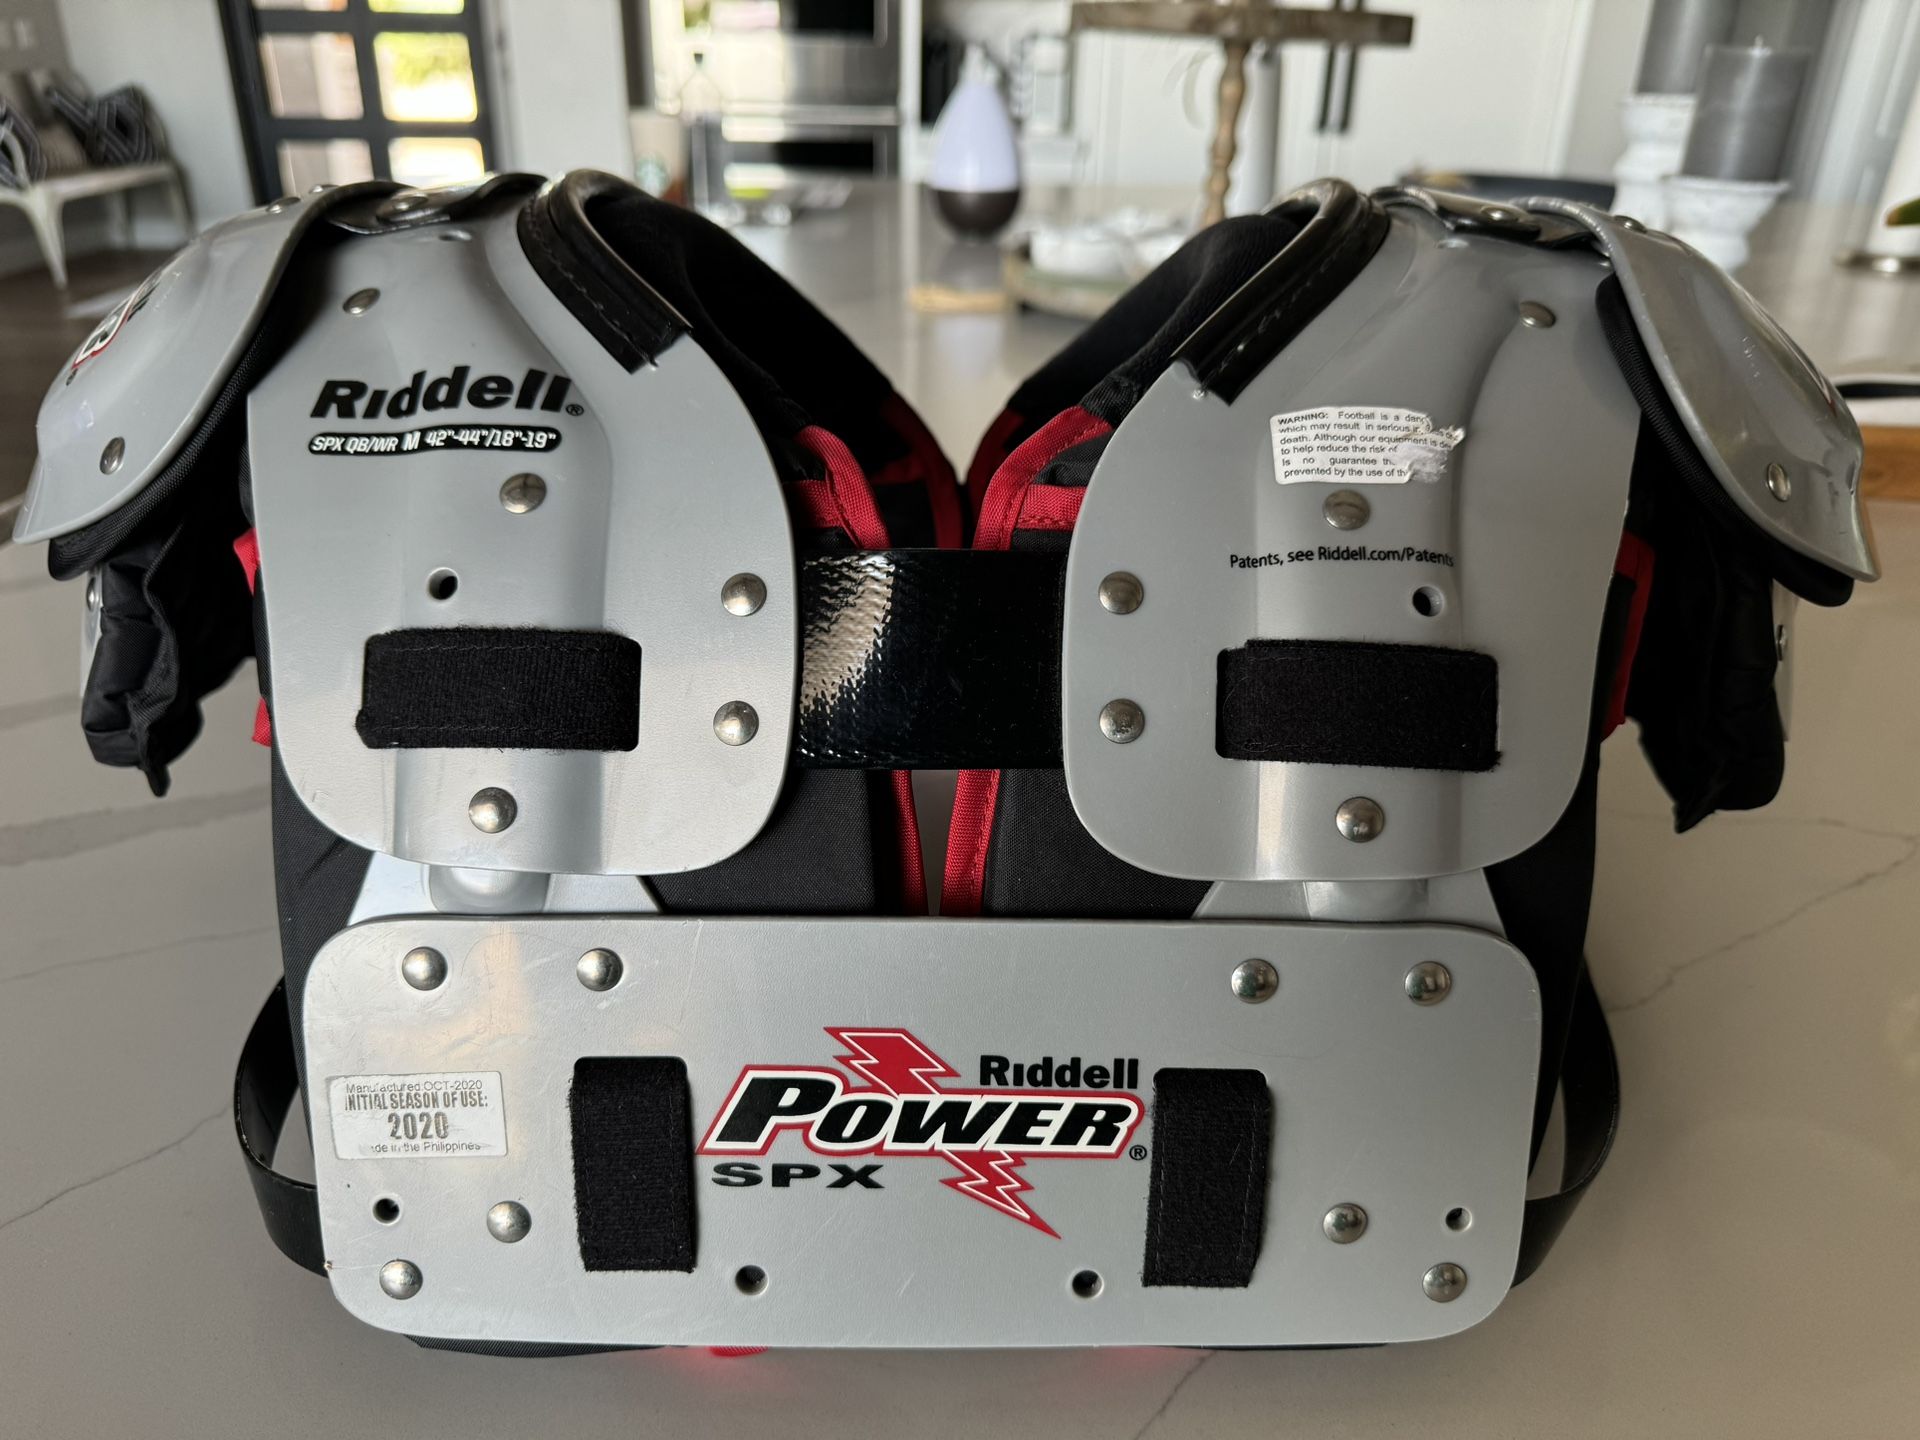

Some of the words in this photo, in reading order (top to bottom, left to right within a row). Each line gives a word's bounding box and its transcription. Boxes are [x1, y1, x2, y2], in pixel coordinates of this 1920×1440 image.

[310, 365, 571, 419] Riddell
[1278, 412, 1329, 425] WARNING:
[1338, 411, 1375, 420] Football
[1381, 413, 1388, 421] is
[1278, 424, 1307, 434] which
[1310, 423, 1331, 431] may
[1333, 422, 1360, 430] result
[1365, 422, 1373, 430] in
[1376, 423, 1410, 432] serious
[311, 436, 343, 452] SPX
[345, 435, 398, 453] QB/WR
[402, 430, 420, 451] M
[1280, 434, 1311, 445] death.
[1313, 433, 1357, 443] Although
[1430, 438, 1437, 447] is
[1293, 445, 1314, 454] help
[1316, 444, 1349, 452] reduce
[1352, 444, 1366, 453] the
[1369, 445, 1386, 453] risk
[1329, 457, 1377, 466] guarantee
[1284, 467, 1332, 479] prevented
[1334, 467, 1345, 477] by
[1348, 468, 1363, 476] the
[1385, 468, 1395, 477] of
[1230, 553, 1283, 569] Patents,
[1288, 548, 1314, 562] see
[1318, 546, 1455, 568] Riddell.com/Patents
[979, 1055, 1139, 1090] Riddell
[424, 1080, 482, 1091] OCT-2020
[390, 1091, 439, 1110] SEASON
[443, 1091, 458, 1108] OF
[461, 1090, 488, 1107] USE:
[387, 1112, 449, 1140] 2020
[424, 1142, 481, 1153] Philippines
[711, 1160, 884, 1189] SPX
